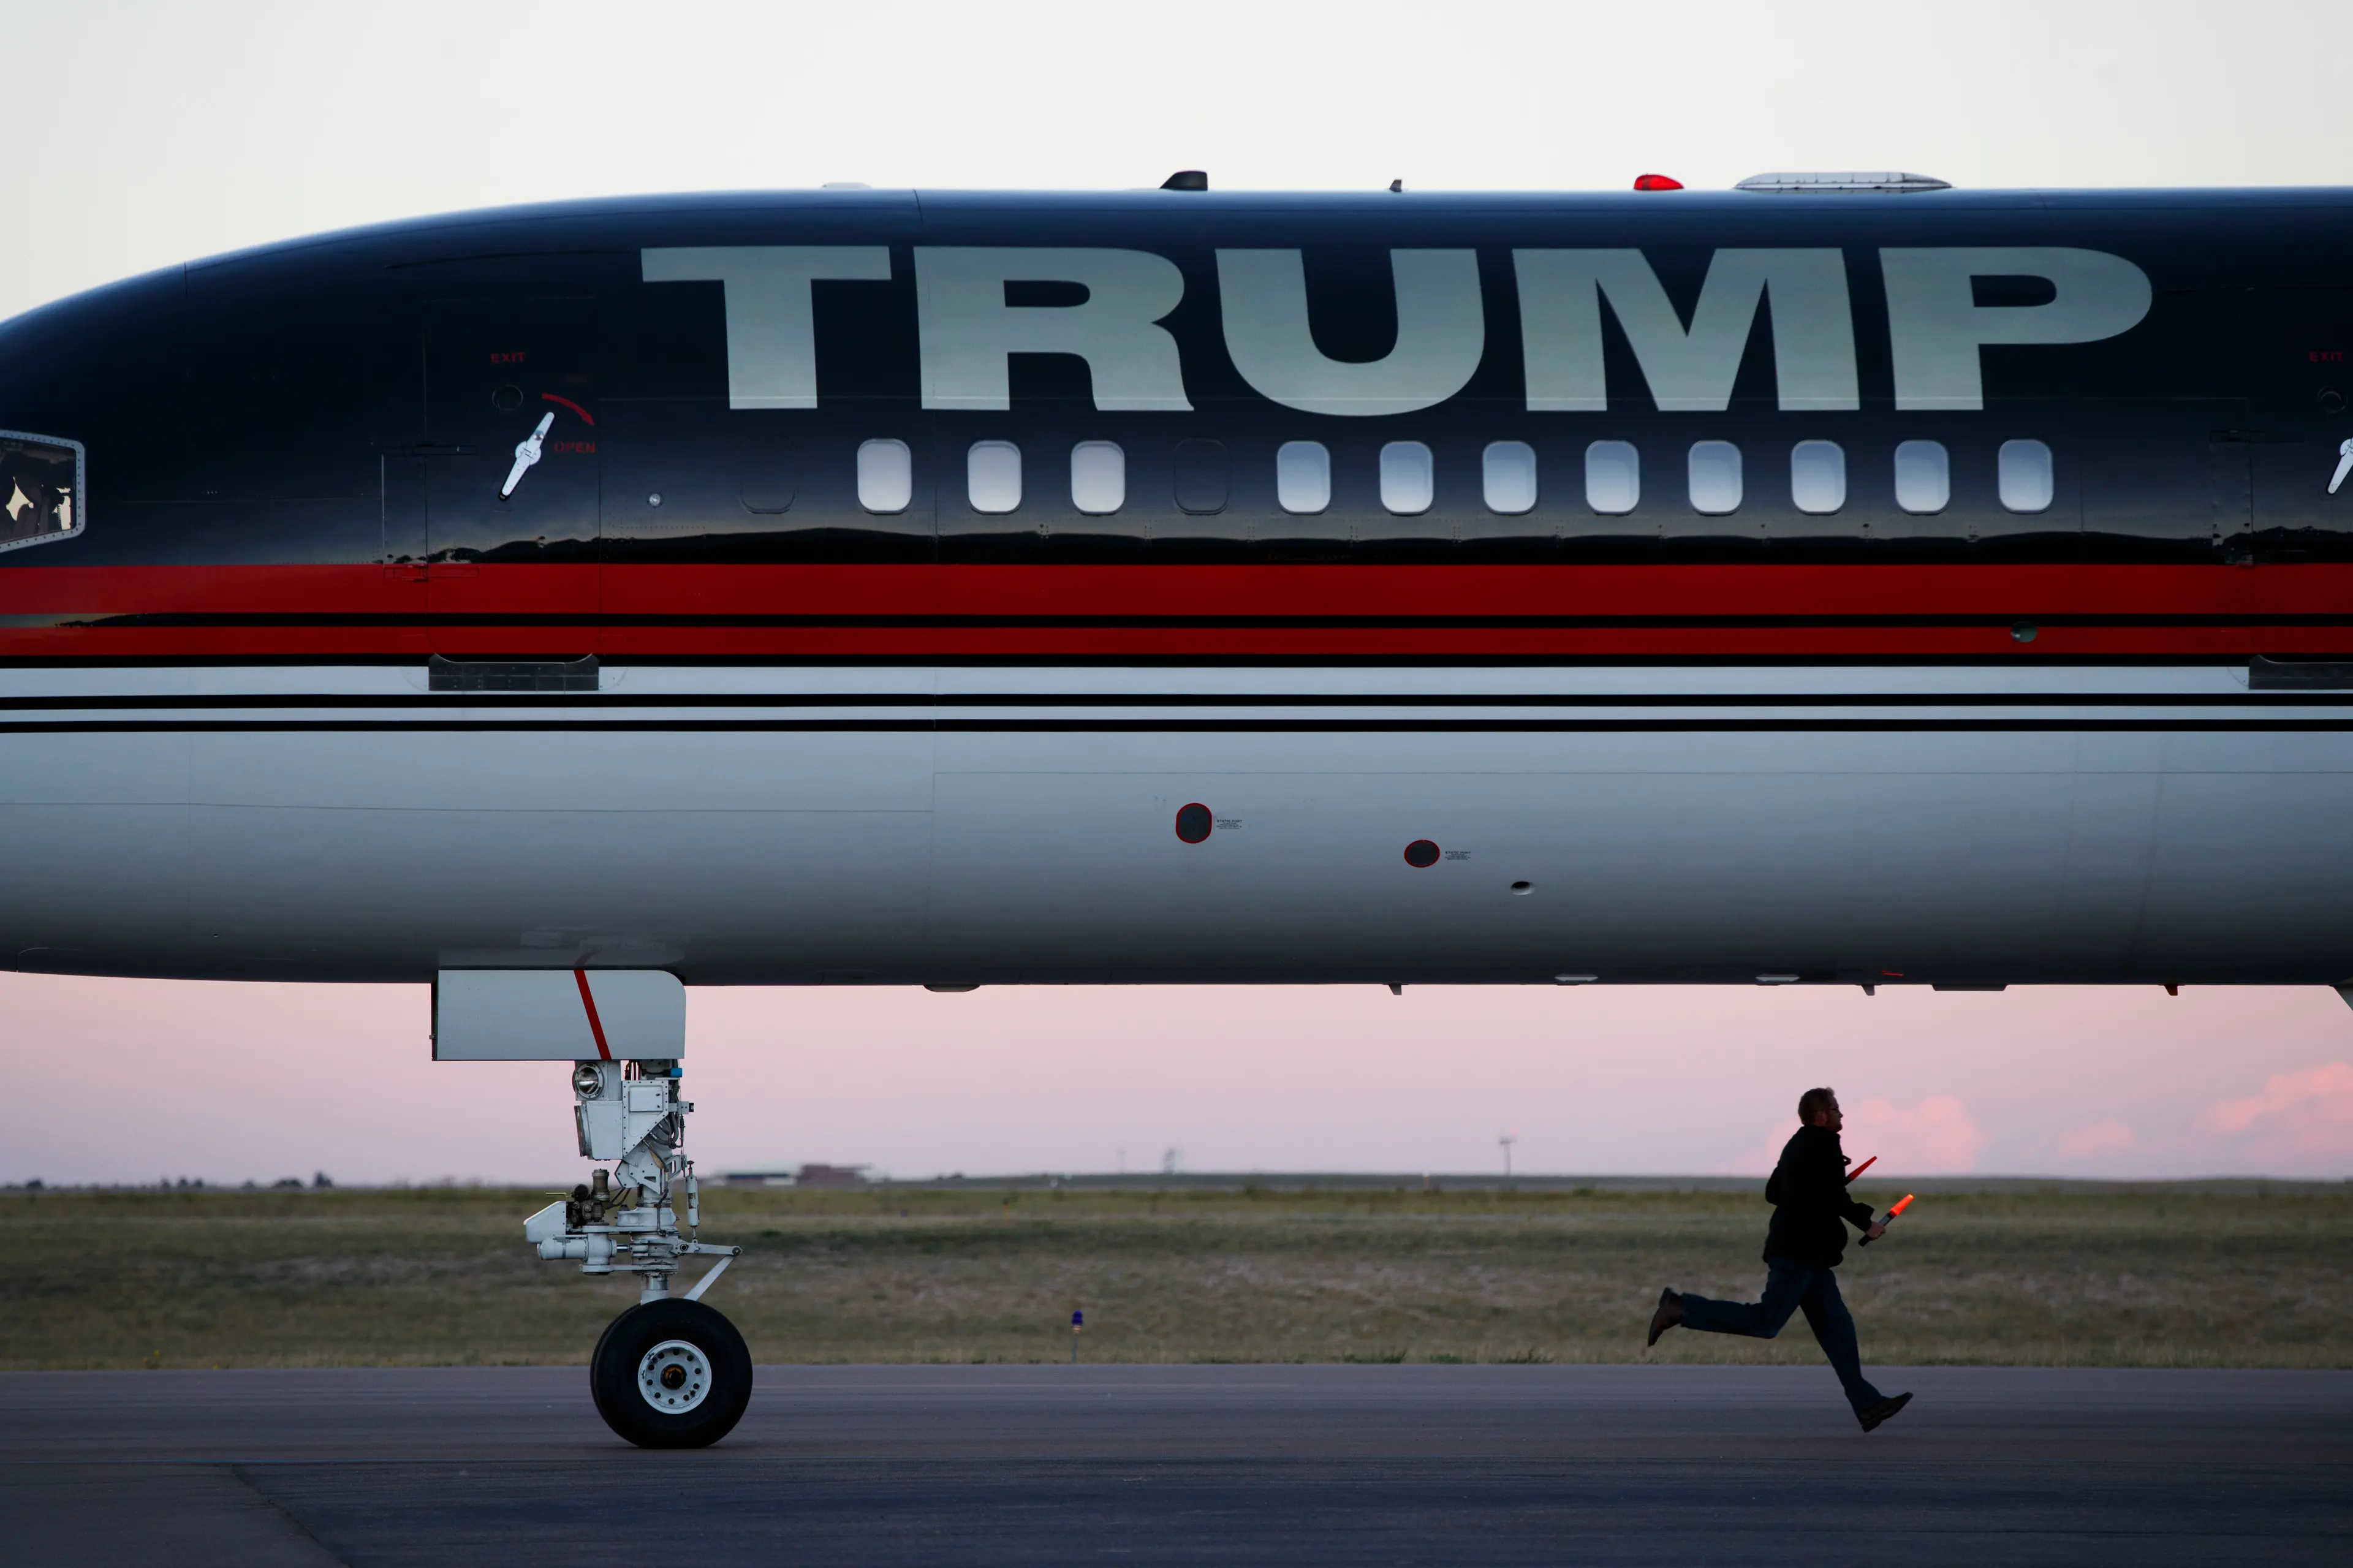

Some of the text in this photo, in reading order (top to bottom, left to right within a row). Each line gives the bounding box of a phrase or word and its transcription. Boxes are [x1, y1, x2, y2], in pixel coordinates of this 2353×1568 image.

[641, 246, 2151, 416] TRUMP
[490, 352, 525, 363] EXIT
[2309, 351, 2344, 362] EXIT
[553, 441, 596, 453] OPEN
